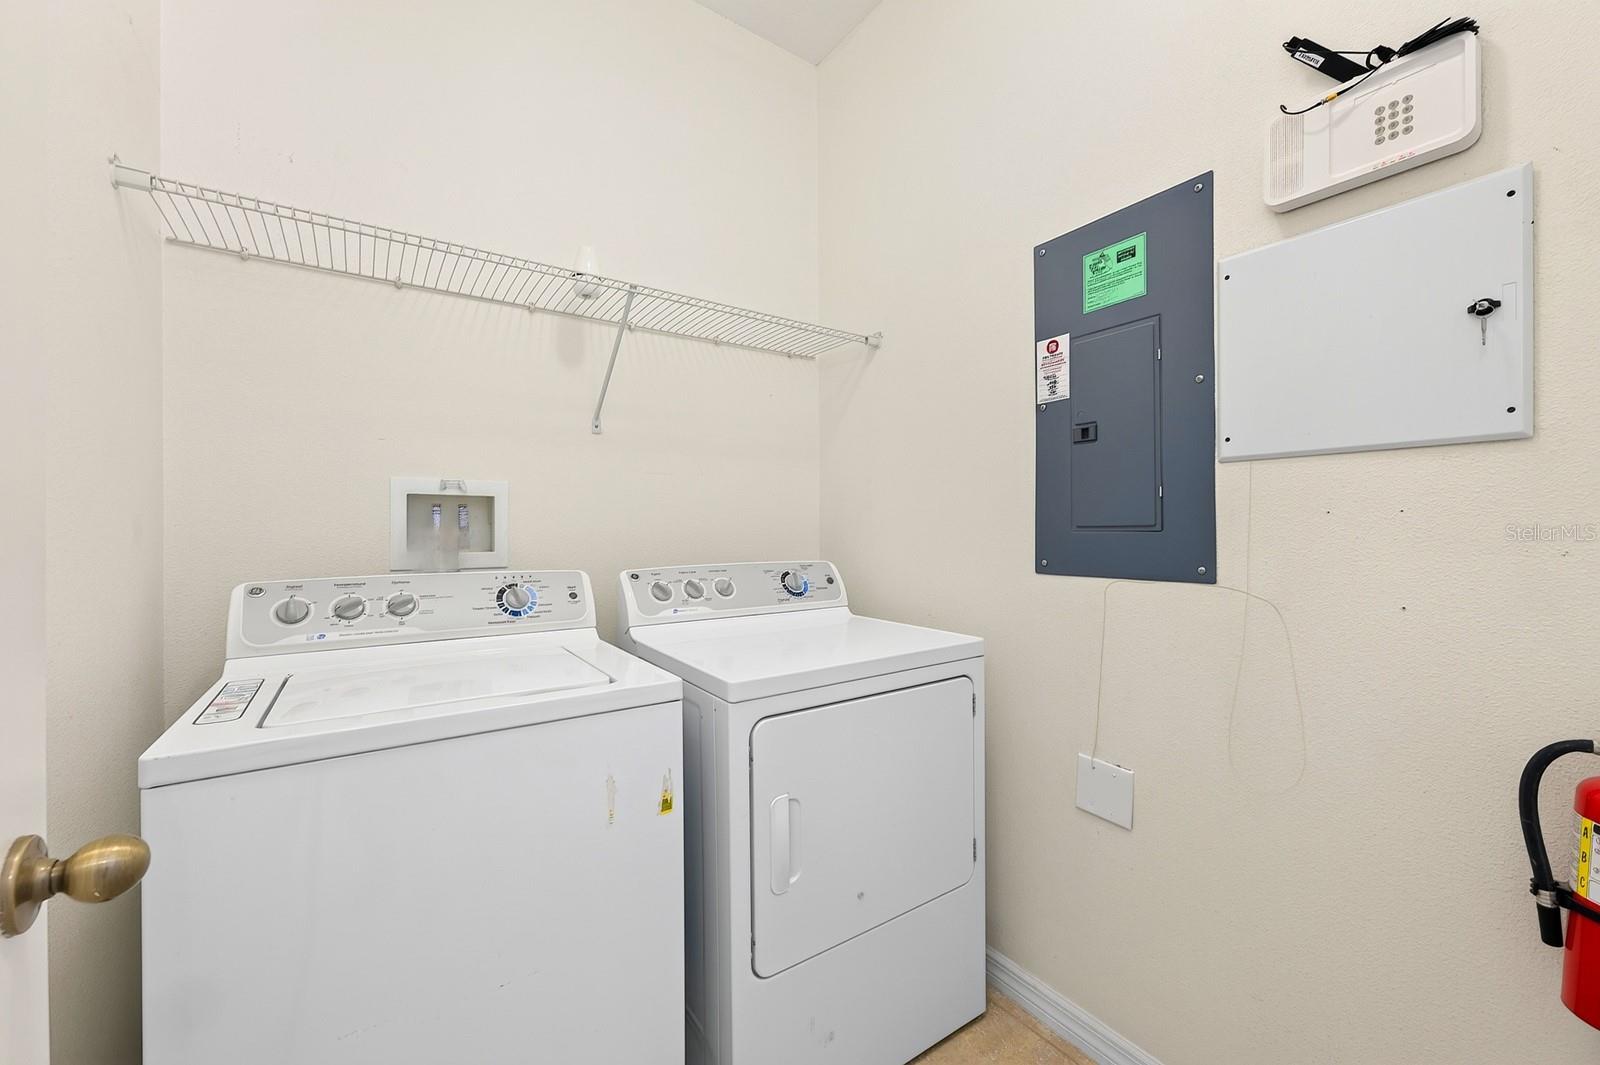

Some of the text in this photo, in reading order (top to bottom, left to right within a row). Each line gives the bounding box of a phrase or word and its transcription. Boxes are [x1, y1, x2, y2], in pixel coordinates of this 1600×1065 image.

[1580, 827, 1588, 888] A B C
